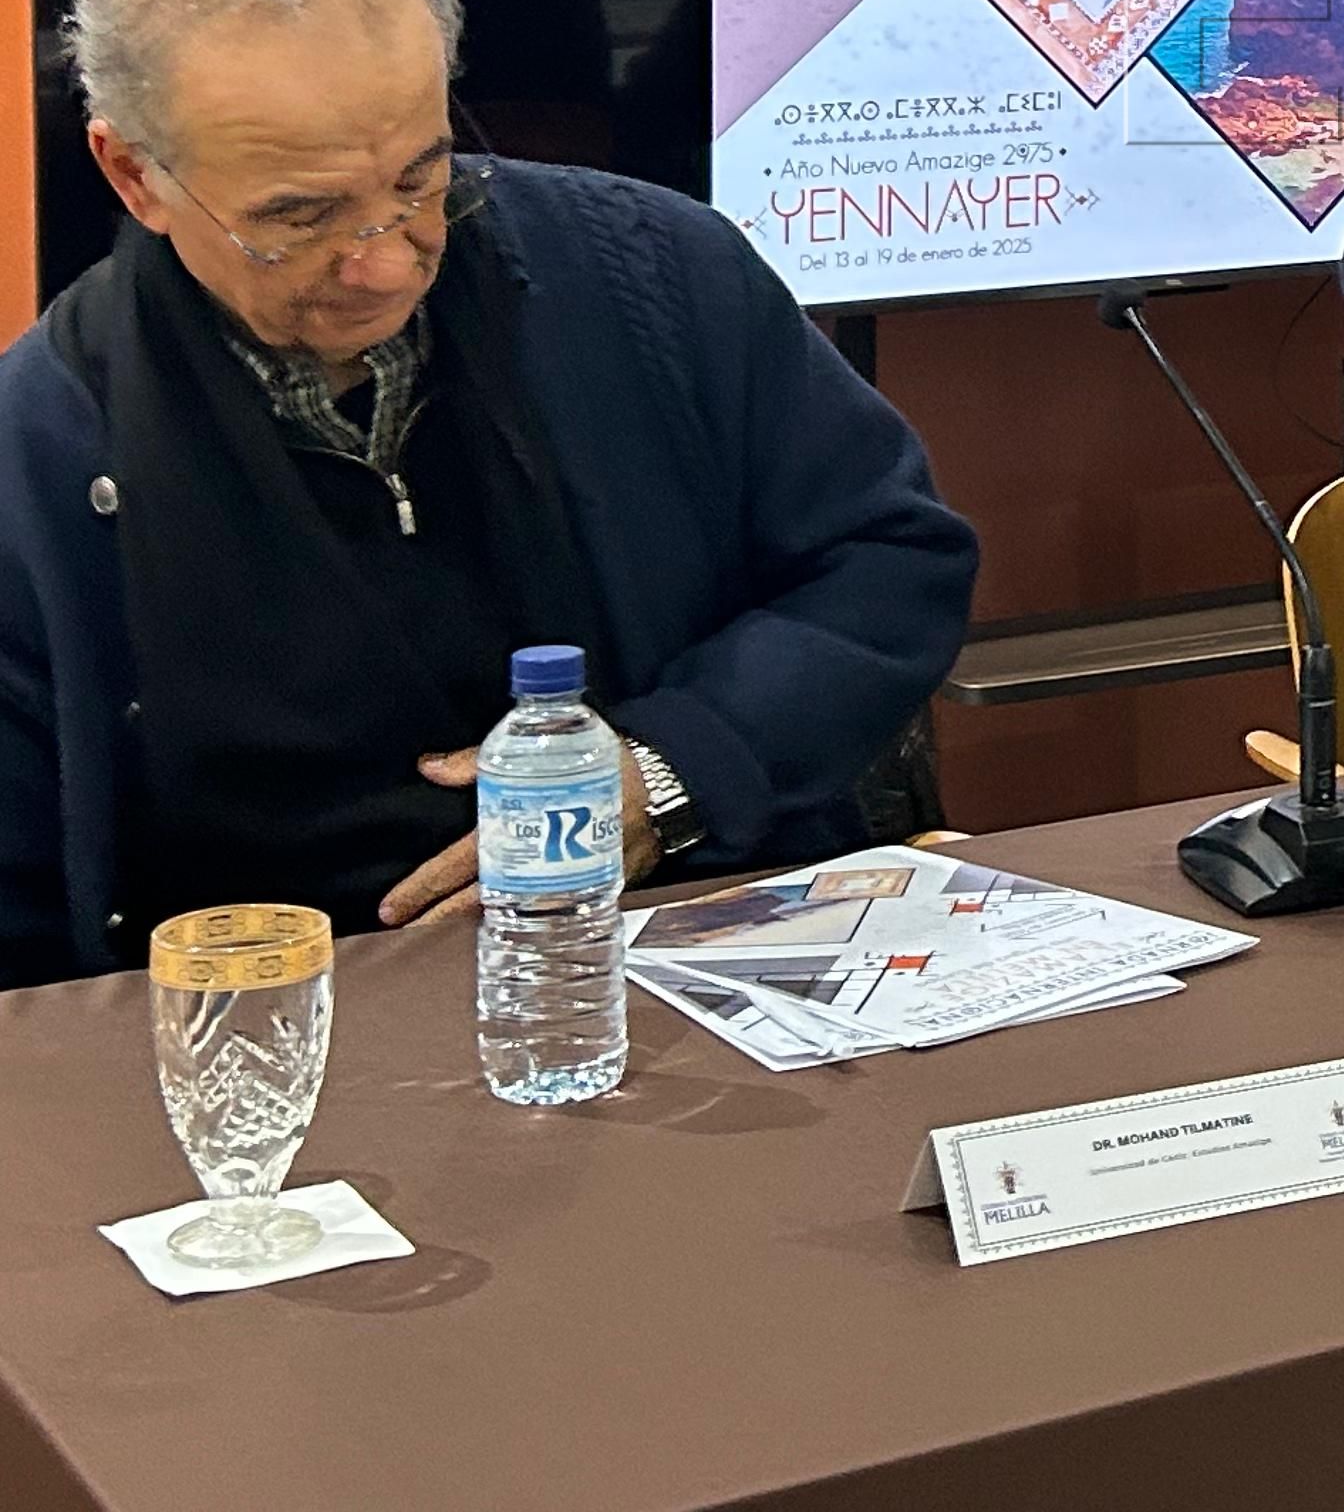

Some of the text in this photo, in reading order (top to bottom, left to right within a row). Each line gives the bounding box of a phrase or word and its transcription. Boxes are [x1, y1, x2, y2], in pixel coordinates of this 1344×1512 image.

[780, 141, 1054, 180] Año Nuevo Amazige 2975
[770, 173, 1062, 245] YENNAYER
[799, 237, 1033, 271] Del 13 al 19 de enero de 2025
[1092, 1113, 1254, 1152] DR. MOHAND TILMATINE
[984, 1202, 1051, 1225] MELILLA
